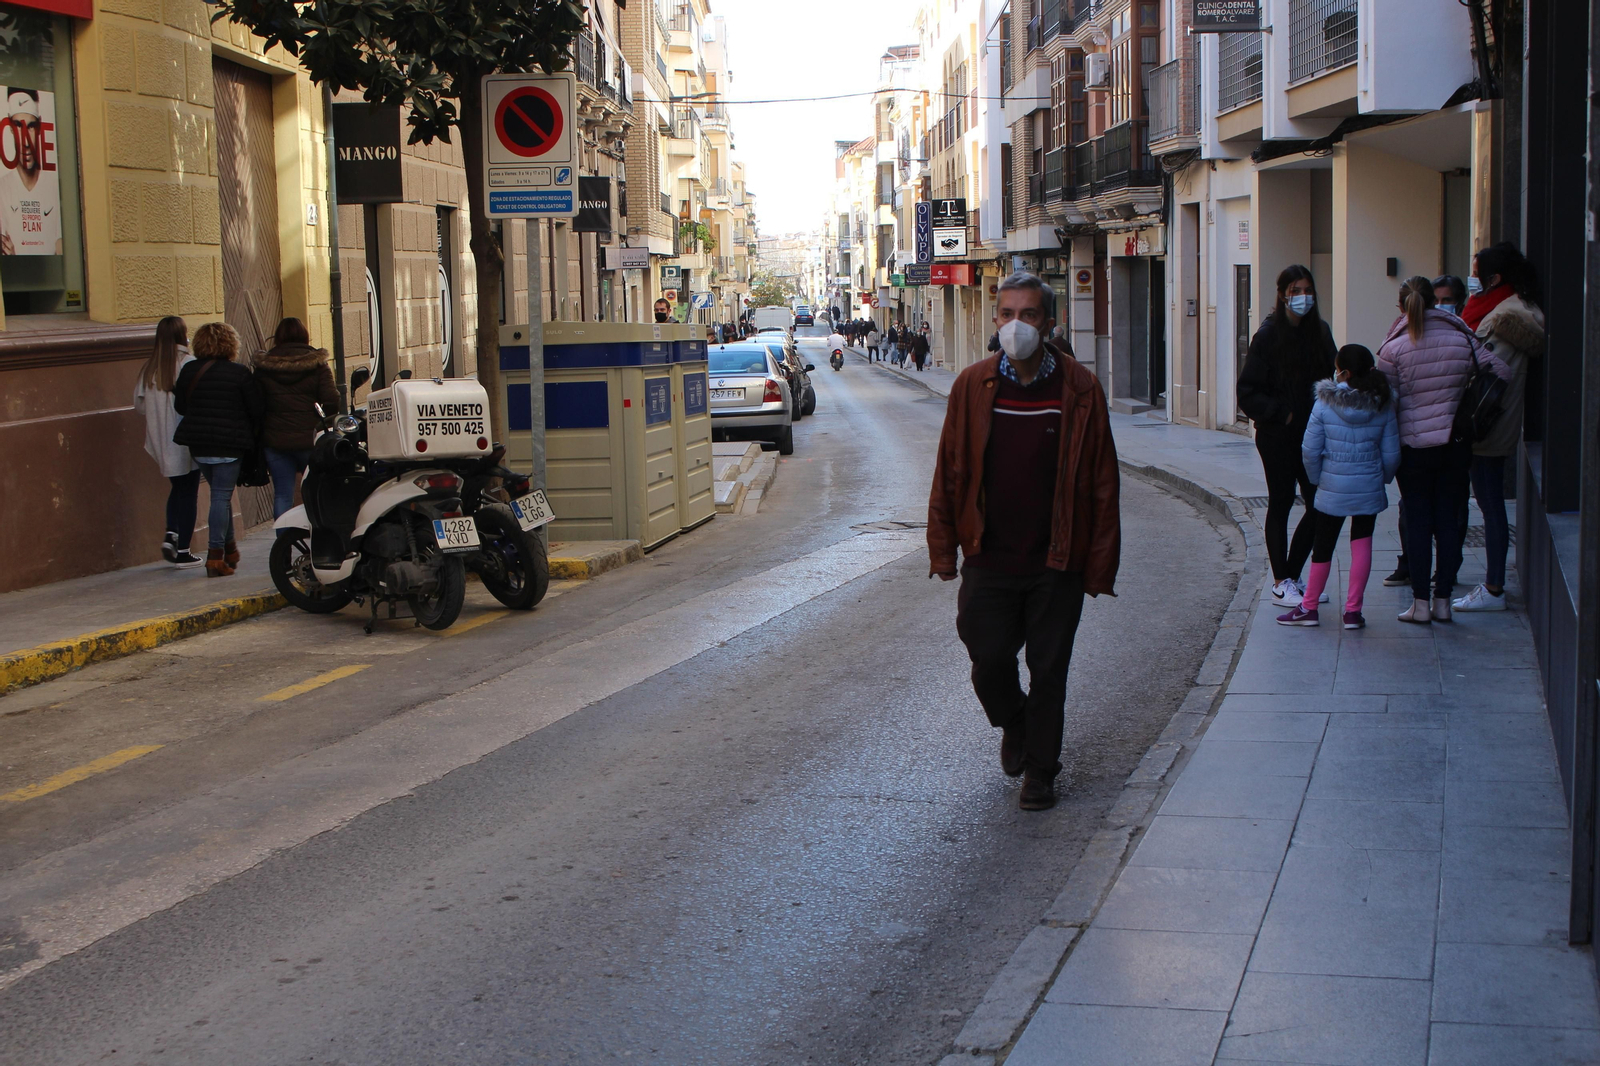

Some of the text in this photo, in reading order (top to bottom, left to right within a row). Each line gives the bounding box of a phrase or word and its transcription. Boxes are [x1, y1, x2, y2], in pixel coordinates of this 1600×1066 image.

[0, 117, 56, 171] ONE
[339, 146, 397, 160] MANGO
[918, 205, 928, 260] OLYMPO
[376, 398, 392, 408] VENETO
[417, 404, 482, 416] VIA VENETO
[418, 422, 484, 436] 957 500 425
[519, 493, 545, 511] 3213
[524, 506, 544, 523] LGG
[444, 520, 473, 533] 4282
[447, 533, 468, 544] KVD
